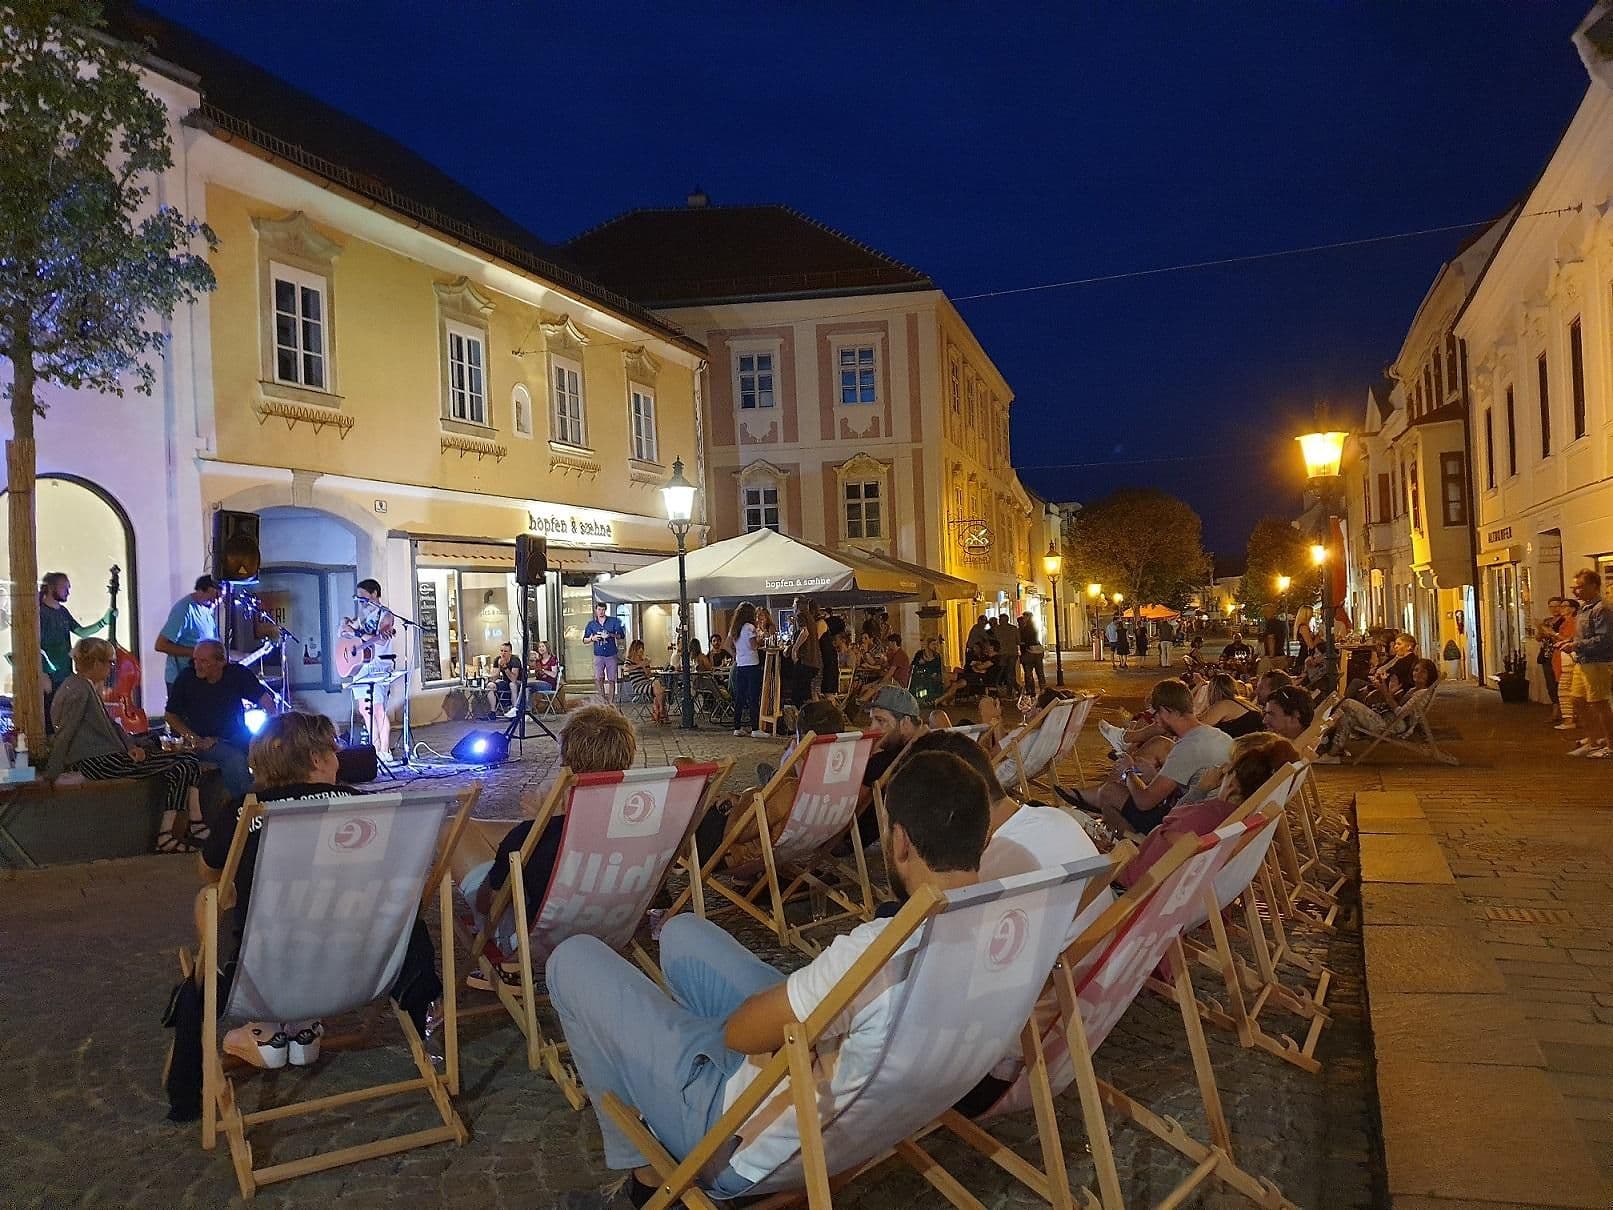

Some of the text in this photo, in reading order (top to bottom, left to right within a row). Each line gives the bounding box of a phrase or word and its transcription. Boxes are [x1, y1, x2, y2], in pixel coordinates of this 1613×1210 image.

[527, 510, 568, 536] hopfen
[570, 516, 578, 534] &
[765, 578, 794, 589] hopfen
